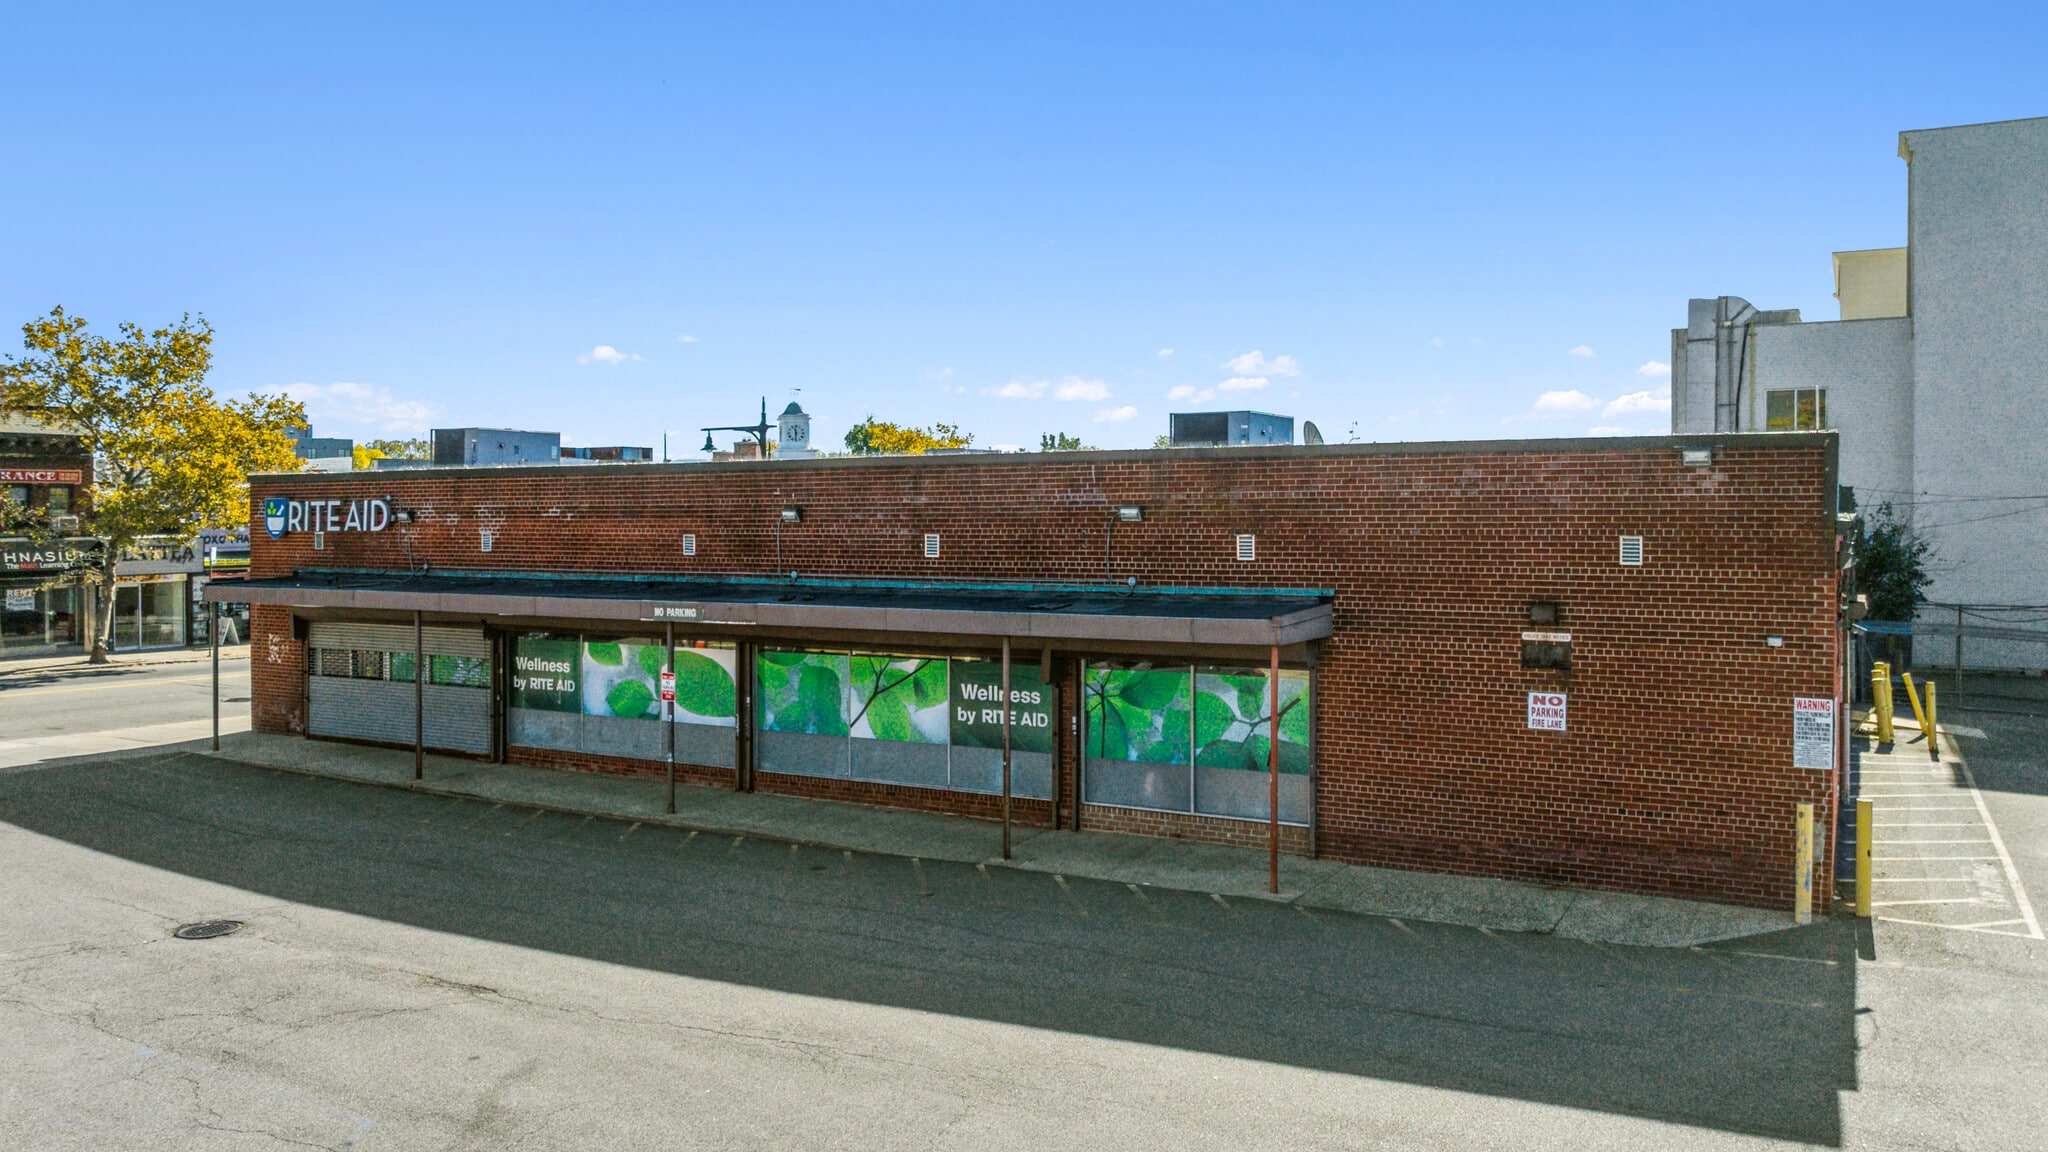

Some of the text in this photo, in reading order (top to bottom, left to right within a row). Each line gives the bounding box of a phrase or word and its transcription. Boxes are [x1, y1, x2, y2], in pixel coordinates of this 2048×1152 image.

[288, 500, 390, 532] RITE AID
[4, 551, 91, 563] HNASIU
[40, 561, 69, 570] Learning
[654, 607, 697, 618] NO PARKING
[516, 656, 570, 673] Wellness
[513, 676, 576, 692] by RITE AID
[1533, 695, 1563, 707] NO
[1796, 700, 1831, 711] WARNING
[957, 707, 976, 725] by
[1020, 712, 1049, 728] AID
[1531, 706, 1564, 719] PARKING
[1532, 719, 1562, 729] FIRE LANE
